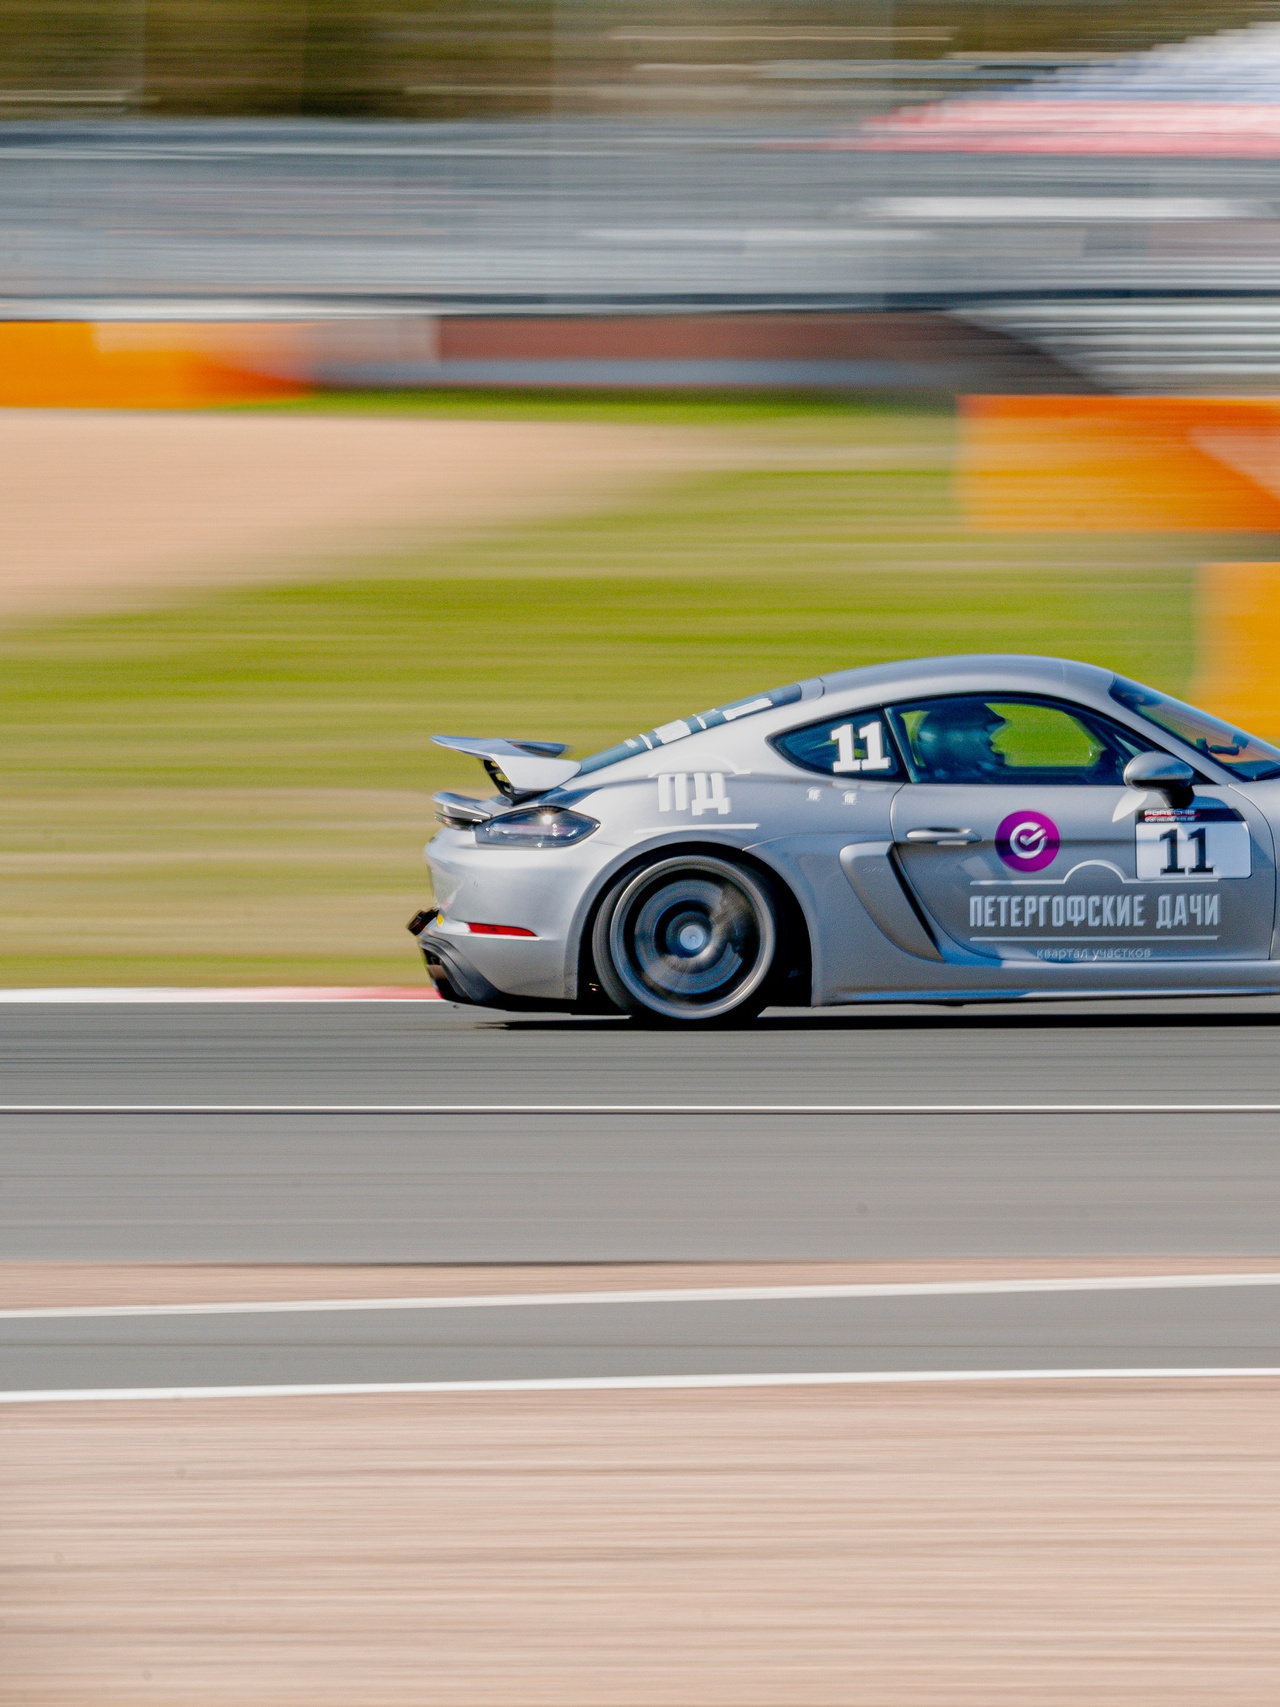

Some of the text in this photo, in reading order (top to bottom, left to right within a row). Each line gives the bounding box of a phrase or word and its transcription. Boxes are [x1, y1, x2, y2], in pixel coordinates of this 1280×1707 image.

[830, 721, 891, 773] 11
[657, 772, 732, 816] ПД
[1160, 827, 1214, 876] 11
[969, 894, 1221, 929] ПЕТЕРГОФСКИЕ ДАЧИ
[1036, 947, 1152, 962] квартал участков
